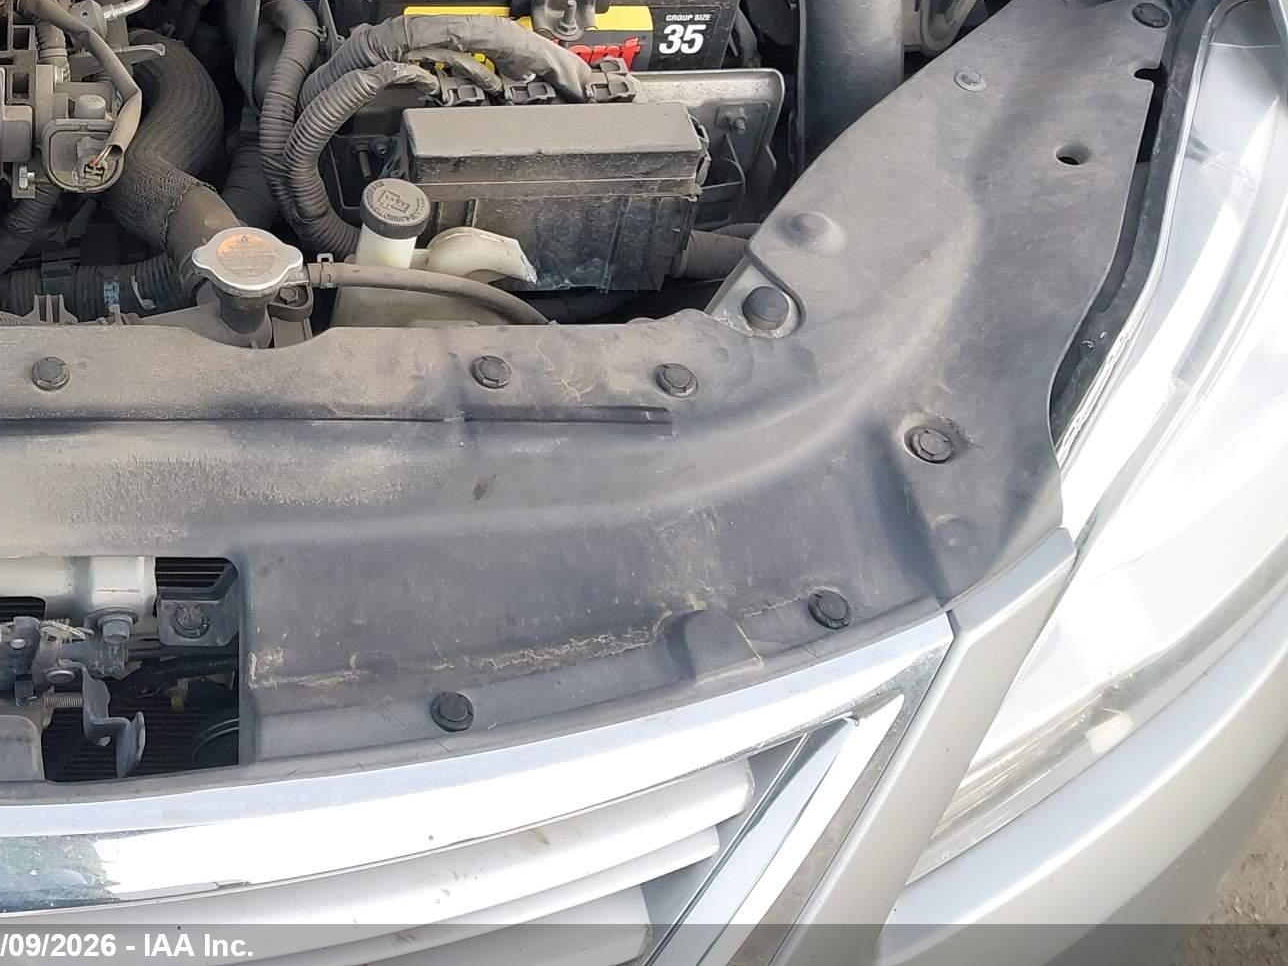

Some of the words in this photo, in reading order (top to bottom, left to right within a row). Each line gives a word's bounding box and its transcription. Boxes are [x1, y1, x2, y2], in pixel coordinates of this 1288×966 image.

[665, 14, 694, 22] GROUP
[694, 13, 712, 21] SIZE
[658, 23, 707, 54] 35
